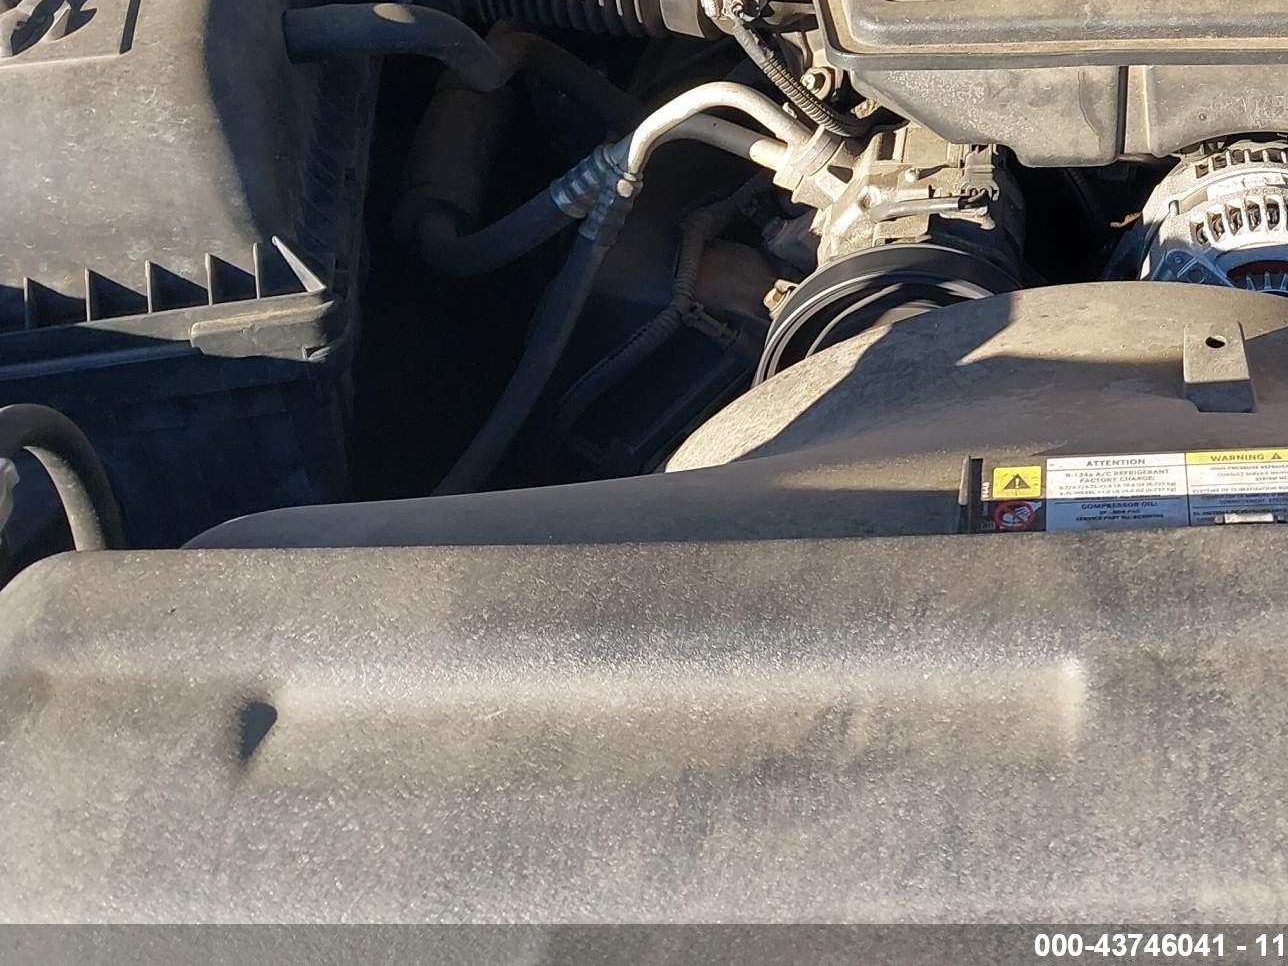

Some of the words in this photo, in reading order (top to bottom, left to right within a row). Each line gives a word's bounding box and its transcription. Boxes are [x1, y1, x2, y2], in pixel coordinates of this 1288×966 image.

[1210, 453, 1265, 462] WARNING
[1086, 458, 1146, 467] ATTENTION
[1080, 502, 1140, 510] COMPRESSOR
